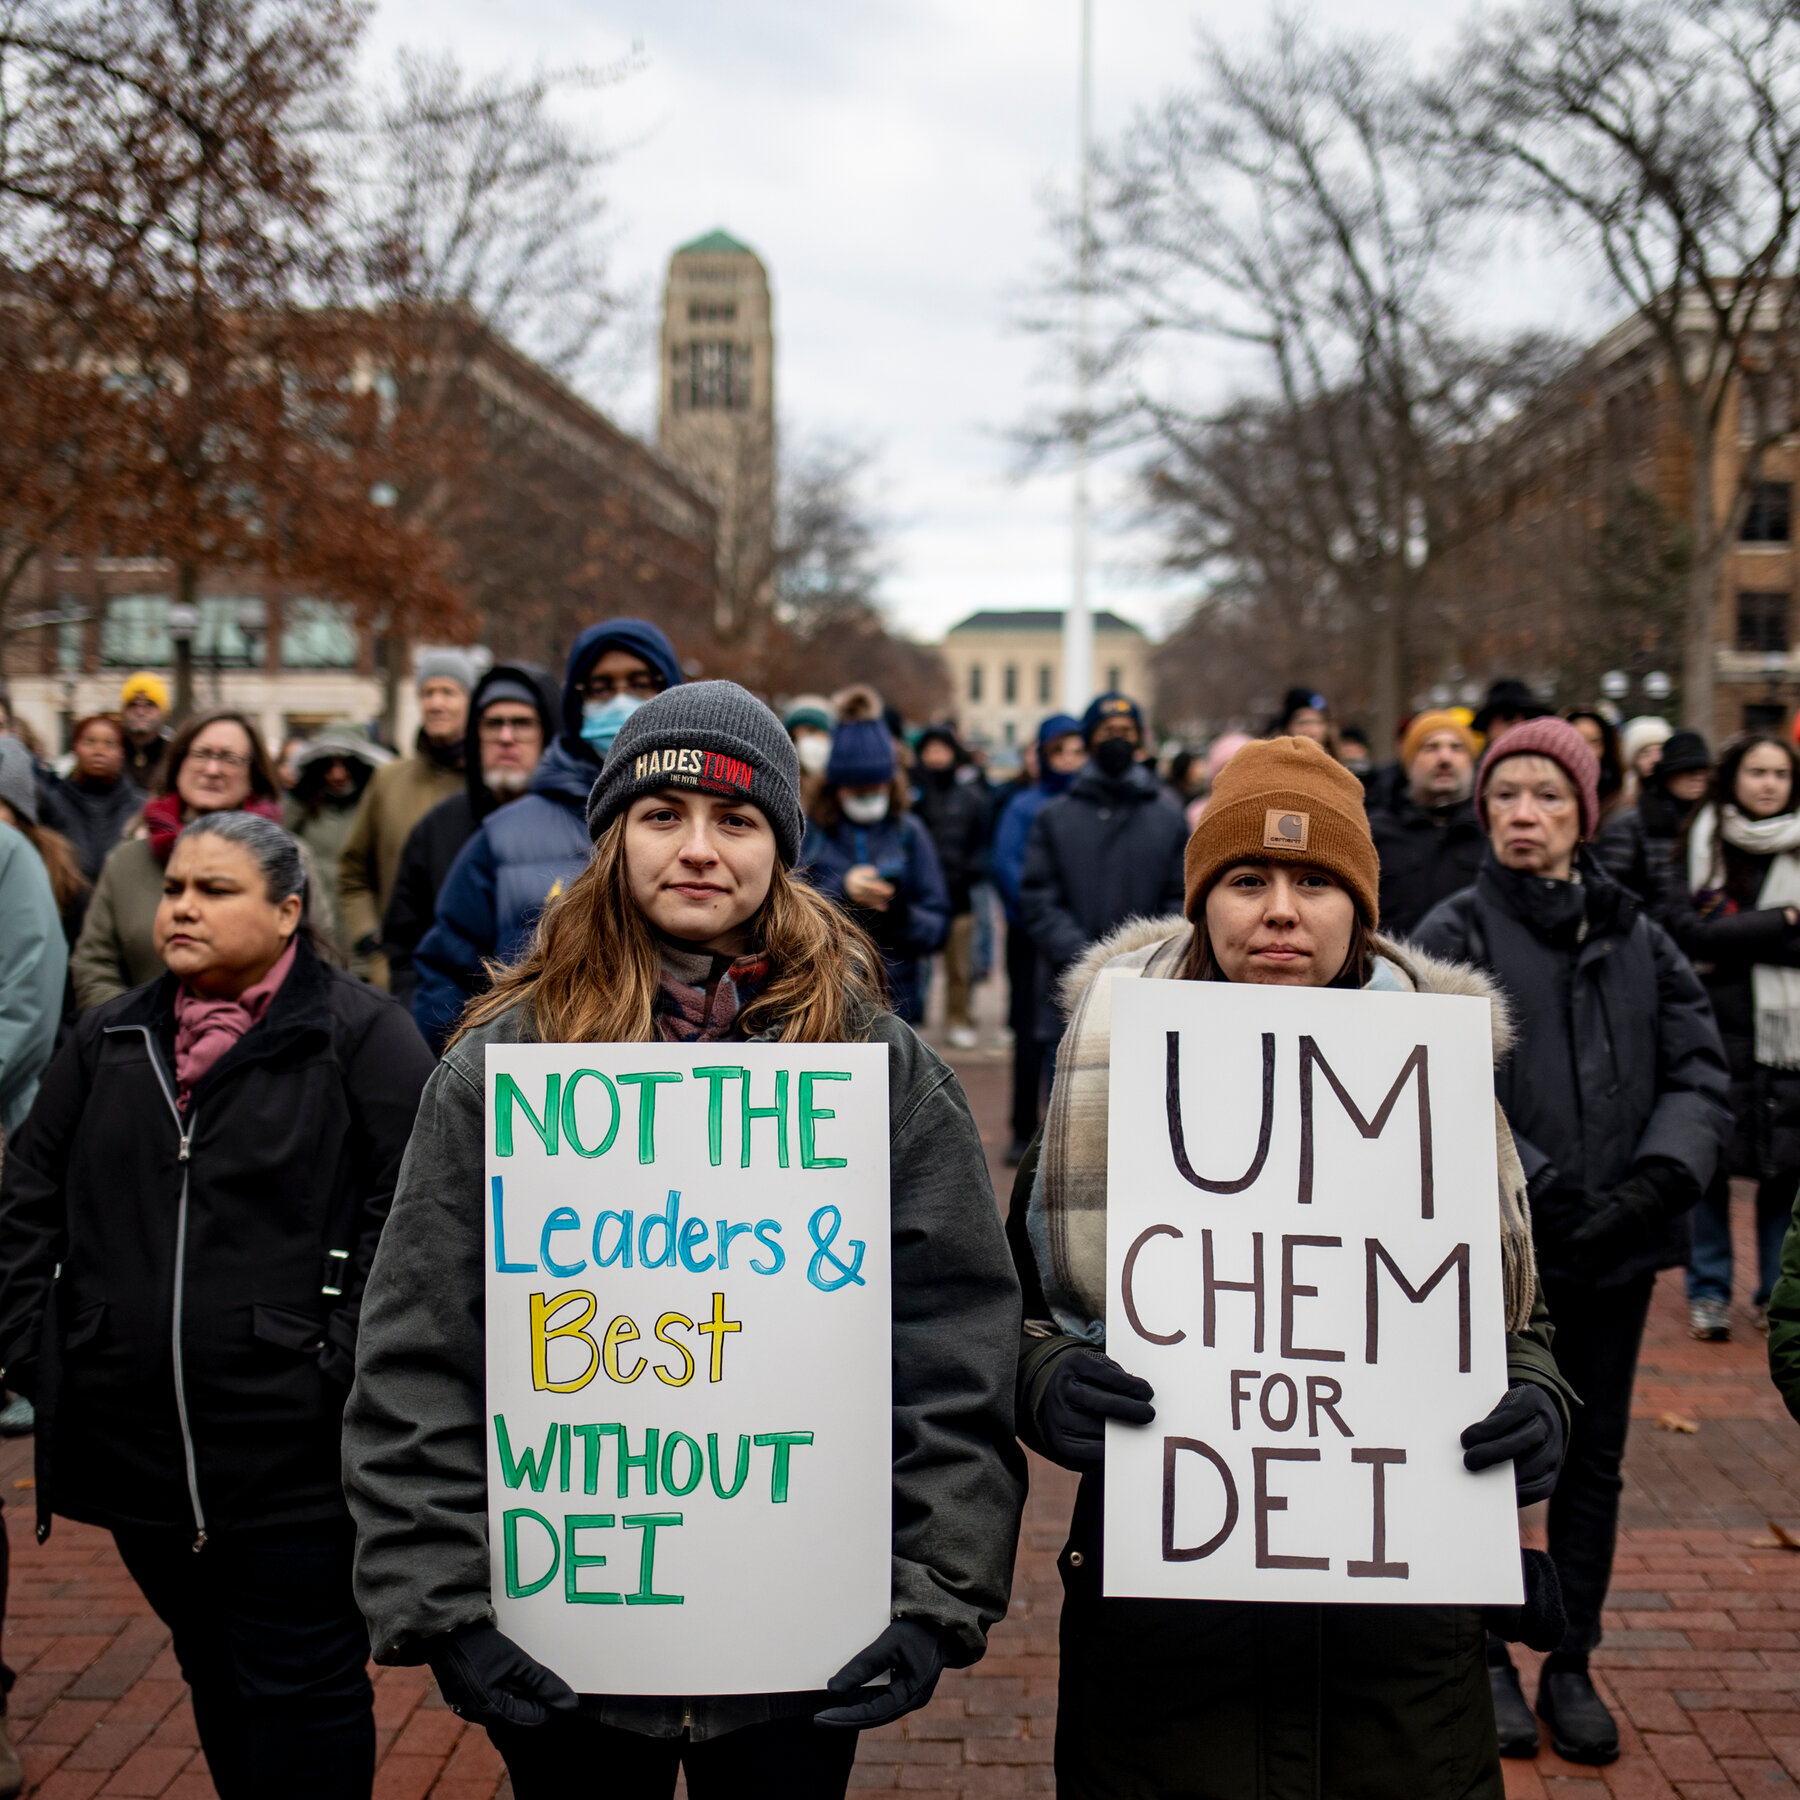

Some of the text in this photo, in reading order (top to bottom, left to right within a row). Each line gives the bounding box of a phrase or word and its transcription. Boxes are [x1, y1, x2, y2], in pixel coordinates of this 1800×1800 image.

[635, 748, 754, 790] HADESTOWN
[495, 1065, 853, 1170] NOT THE
[1166, 1030, 1435, 1220] UM
[491, 1174, 867, 1293] Leaders &
[529, 1288, 743, 1394] Best
[1121, 1223, 1472, 1375] CHEM
[1230, 1369, 1355, 1439] FOR
[493, 1413, 815, 1503] WITHOUT
[1161, 1435, 1410, 1580] DEI
[502, 1507, 685, 1606] DEI
